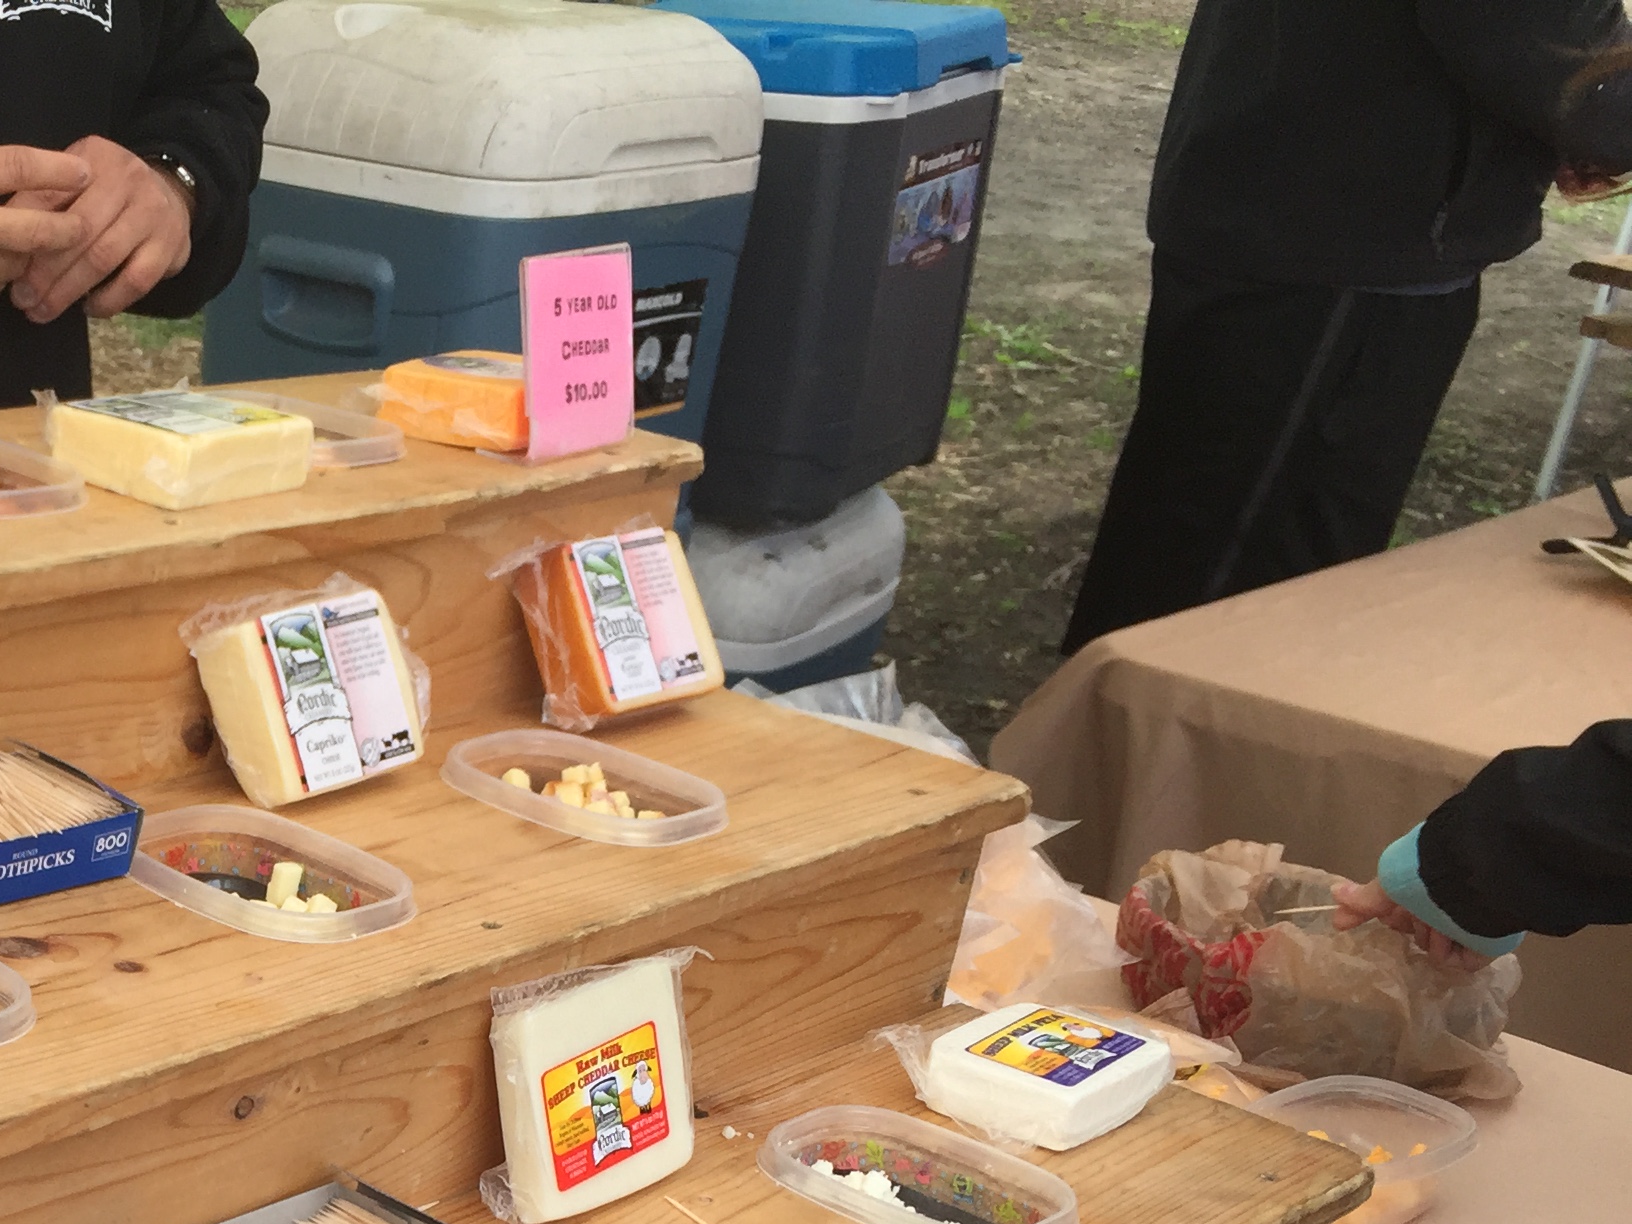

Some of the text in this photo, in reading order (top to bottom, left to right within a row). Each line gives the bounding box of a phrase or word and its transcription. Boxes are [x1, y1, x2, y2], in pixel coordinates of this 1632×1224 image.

[554, 296, 563, 317] 5
[597, 294, 618, 311] OLD
[561, 338, 611, 361] CHEDDAR
[564, 380, 608, 405] $10.00
[95, 831, 128, 853] 800
[548, 1047, 657, 1110] SHEEP CHEDDAR CHEESE
